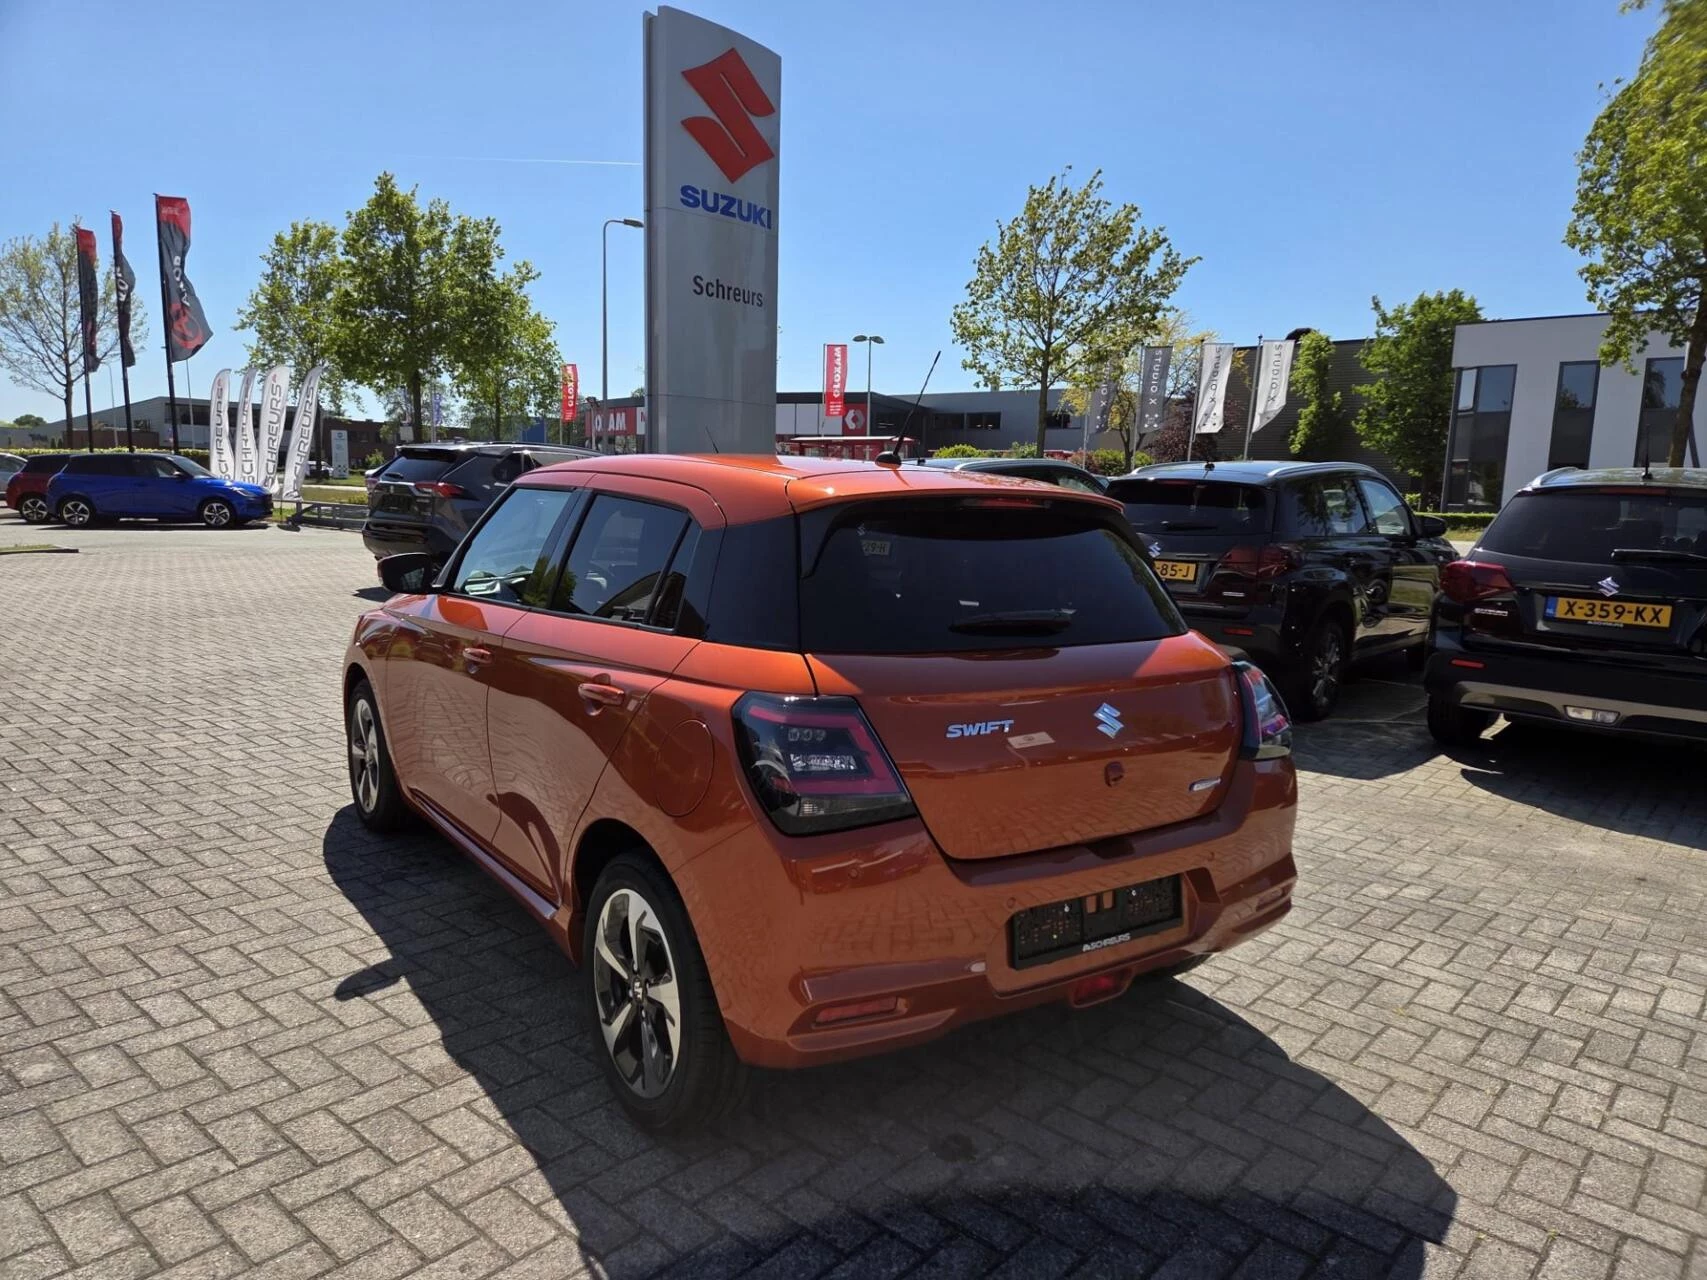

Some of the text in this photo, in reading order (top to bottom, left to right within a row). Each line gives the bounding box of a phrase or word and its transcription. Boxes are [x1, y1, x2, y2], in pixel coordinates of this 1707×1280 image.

[680, 184, 772, 230] SUZUKI
[692, 275, 764, 308] Schreurs
[1150, 349, 1163, 393] STUDIO
[1209, 346, 1222, 404] STUDIO X
[1271, 344, 1283, 390] STUDIO
[241, 386, 254, 483] CHREU
[264, 383, 280, 488] SCHREURS
[1564, 600, 1664, 624] X-359-KX
[946, 719, 1014, 738] SWIFT
